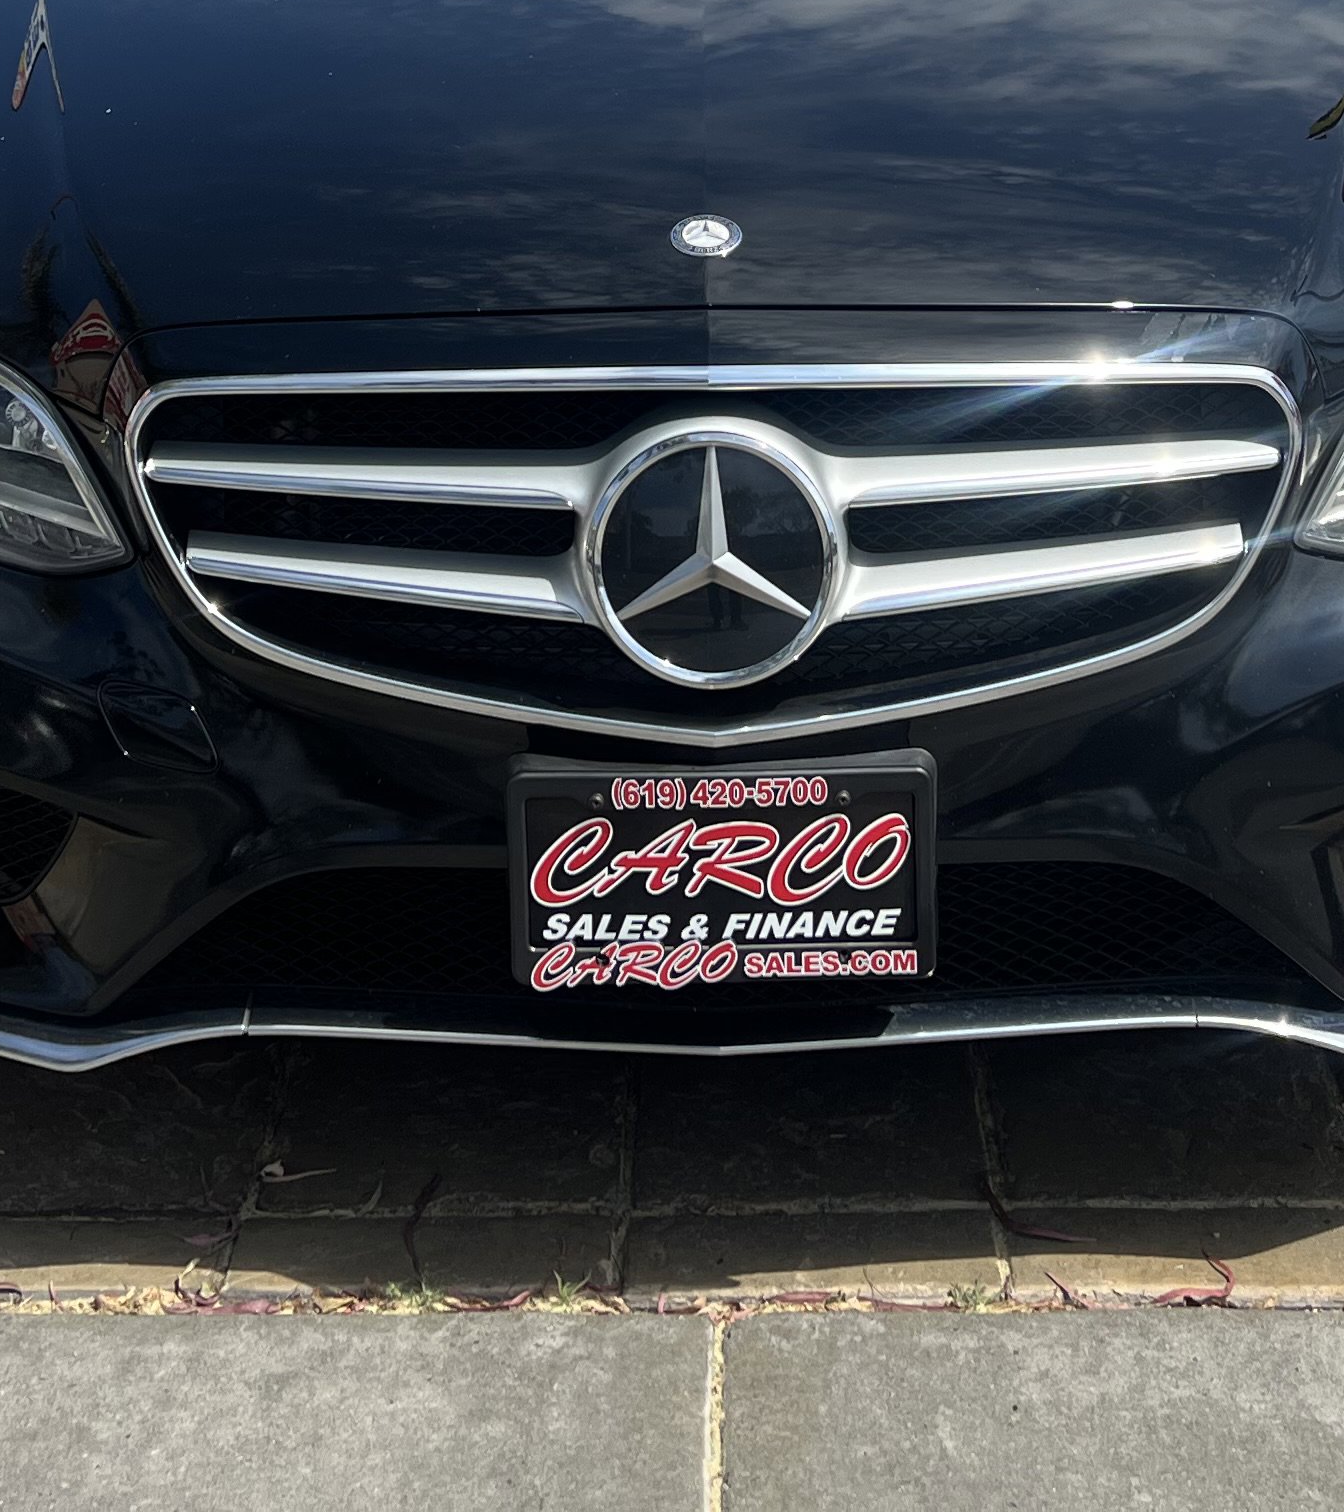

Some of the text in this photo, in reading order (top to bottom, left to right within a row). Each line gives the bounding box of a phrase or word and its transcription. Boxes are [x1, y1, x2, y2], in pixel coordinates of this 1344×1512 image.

[611, 776, 829, 810] (619) 420-5700
[530, 813, 911, 909] CARCO
[543, 908, 902, 942] SALES & FINANCE
[530, 939, 918, 991] CARCO SALES.COM
